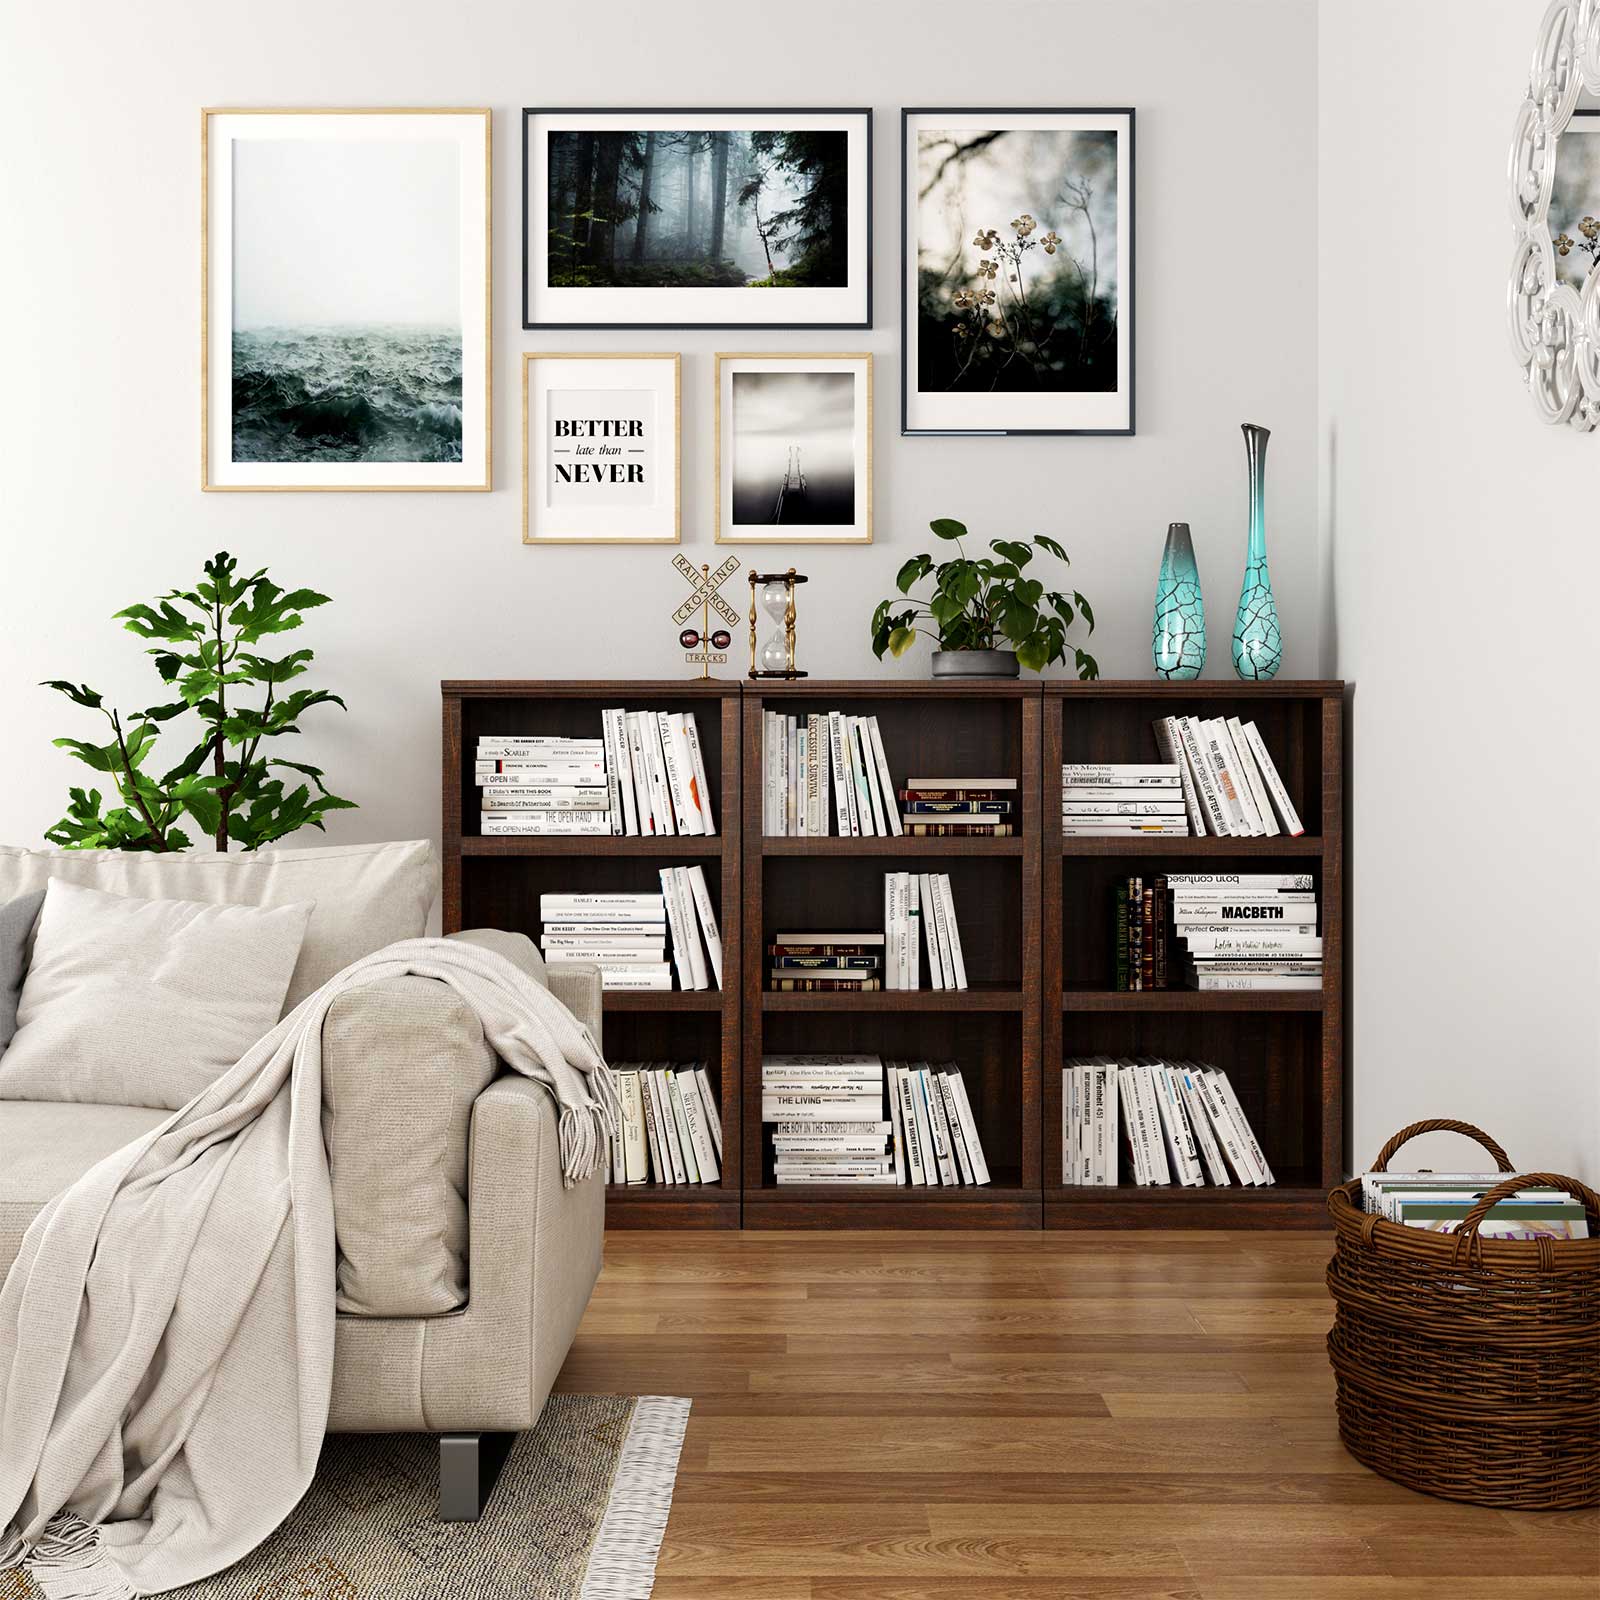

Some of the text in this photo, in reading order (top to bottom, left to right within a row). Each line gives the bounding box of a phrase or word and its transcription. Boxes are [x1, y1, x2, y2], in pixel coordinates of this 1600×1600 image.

[554, 420, 644, 437] BETTER
[576, 444, 622, 455] late than
[554, 464, 644, 483] NEVER
[677, 558, 736, 622] RAIL ROAD
[678, 561, 734, 620] CROSSING
[687, 726, 695, 738] LAST
[1208, 739, 1219, 752] PAUL
[660, 721, 682, 807] FALL ALBERT CAMUS
[808, 717, 818, 798] SUCCESSFUL SURVIVAL
[1179, 717, 1220, 813] FIND THE LOVE OF YOUR LIFE AFTER
[1212, 751, 1225, 770] AUSTER
[831, 716, 847, 821] TAMING AMERICAN POWER WALT
[489, 775, 507, 783] OPEN
[545, 811, 556, 822] THE
[557, 811, 573, 822] OPEN
[575, 811, 591, 822] HAND
[1222, 907, 1283, 918] MACBETH
[941, 1084, 951, 1100] EDGE
[1095, 1071, 1103, 1105] Fahrenheit
[1196, 1073, 1220, 1118] PROPERTY FORMULA
[1212, 1083, 1226, 1106] LAST TICK
[643, 1093, 651, 1111] Quite
[645, 1111, 655, 1132] Cricket
[683, 1092, 698, 1134] SRI LANKA
[1095, 1107, 1103, 1118] 451
[780, 1122, 790, 1133] THE
[791, 1122, 803, 1133] BOY
[804, 1122, 811, 1133] IN
[812, 1122, 823, 1133] THE
[825, 1122, 846, 1133] STRIPED
[901, 1077, 921, 1168] DONNA TARTT THE SECRET HISTORY
[1139, 1120, 1145, 1128] WE
[1253, 1149, 1263, 1163] Wells
